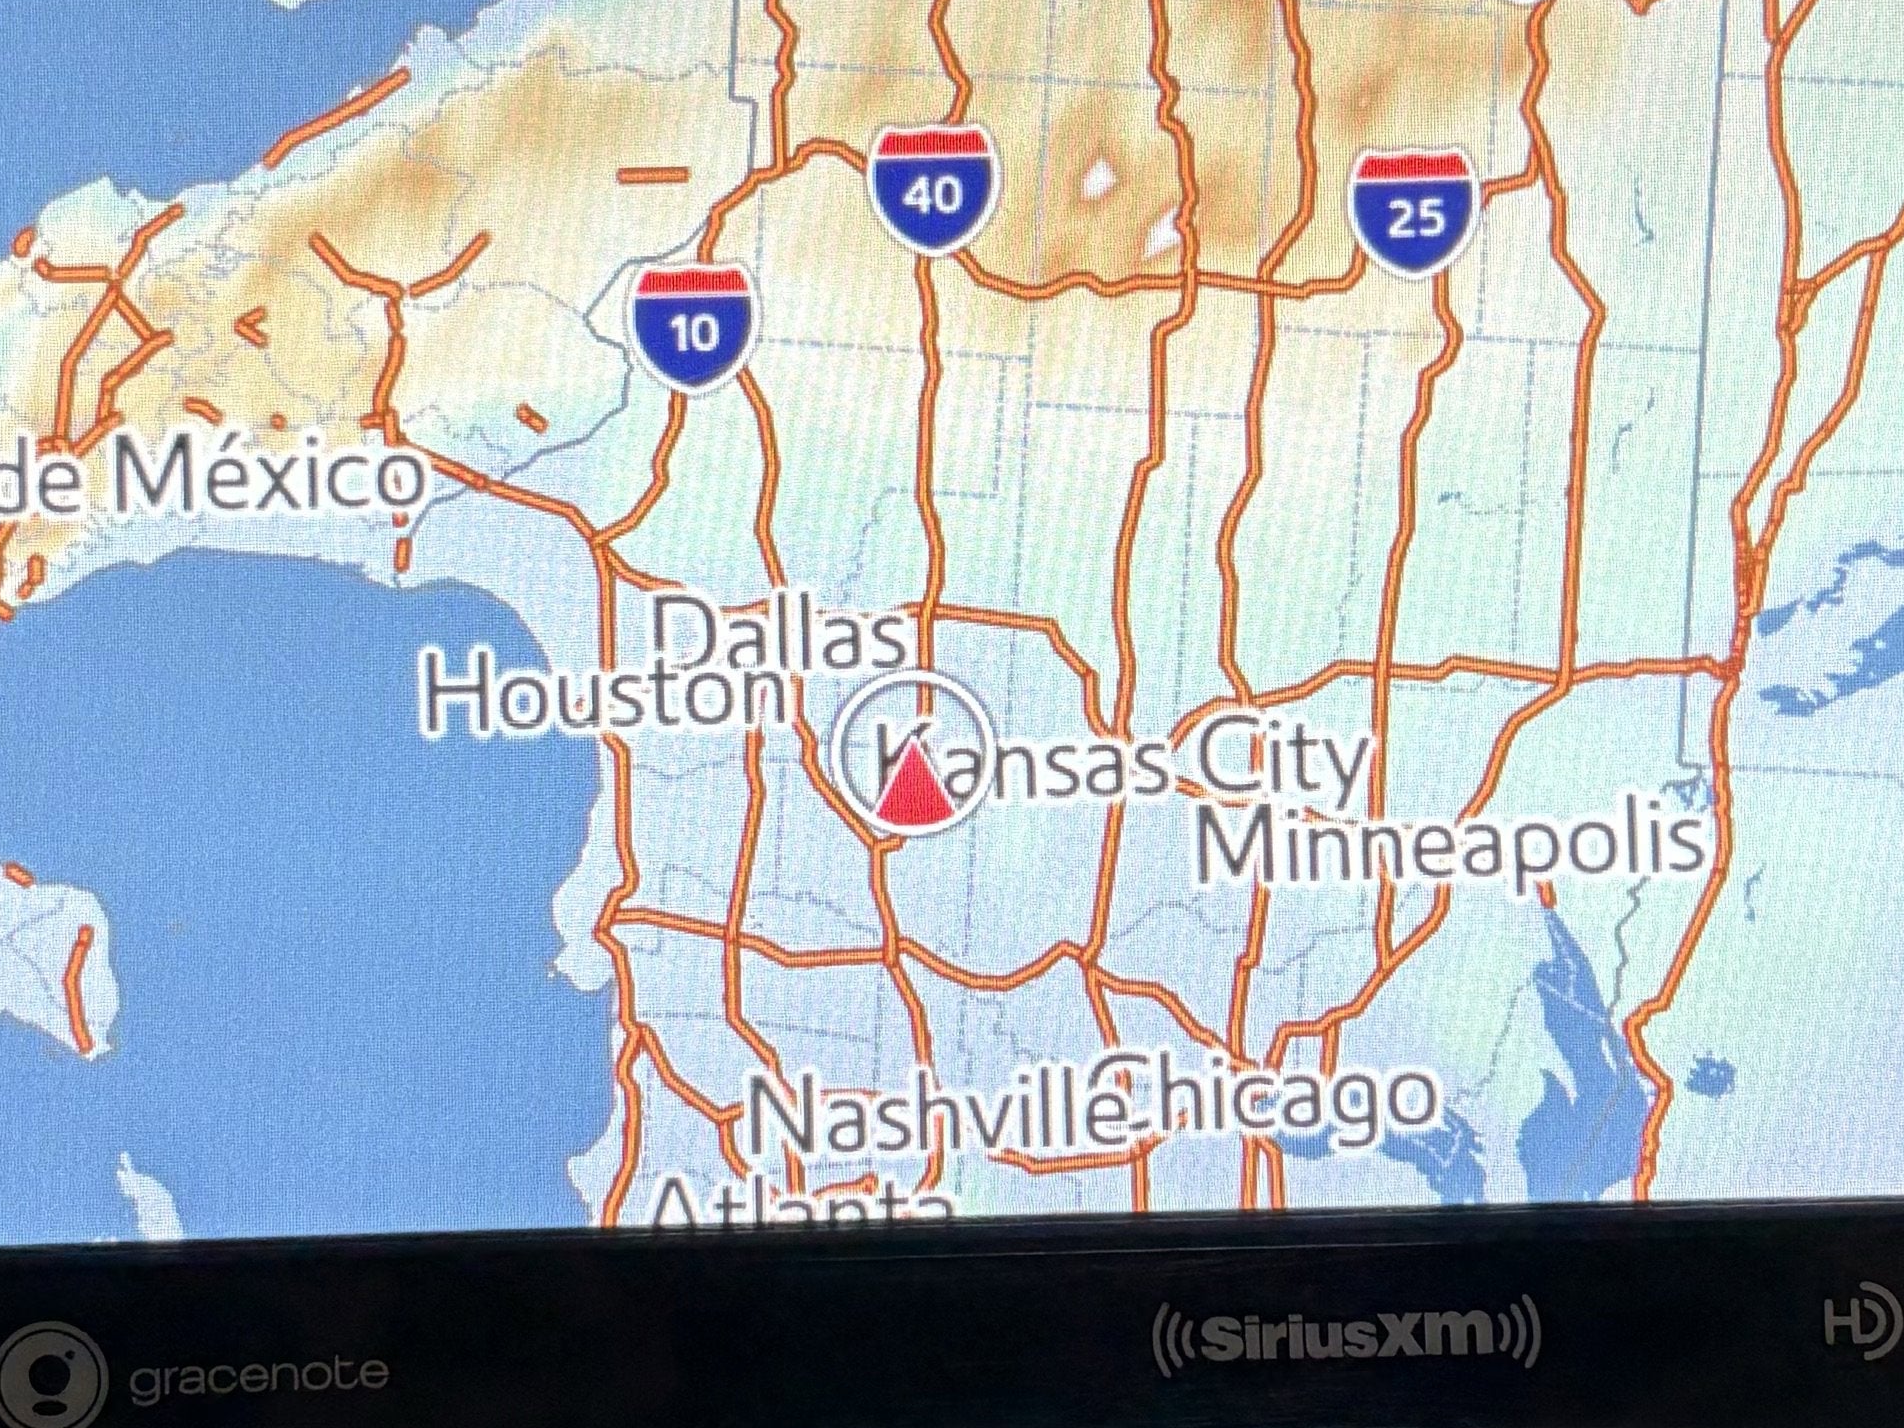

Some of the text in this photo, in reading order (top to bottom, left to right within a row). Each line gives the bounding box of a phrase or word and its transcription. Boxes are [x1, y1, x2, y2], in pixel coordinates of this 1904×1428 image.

[902, 172, 962, 216] 40
[1386, 196, 1445, 240] 25
[670, 312, 719, 356] 10
[114, 428, 426, 514] México
[653, 590, 908, 671] Dallas
[425, 650, 787, 731] Houston
[876, 712, 1371, 815] Kansas City
[1196, 792, 1707, 898] Minneapolis
[750, 1063, 1128, 1155] Nashville
[1087, 1049, 1439, 1150] Chicago
[129, 1354, 390, 1407] gracenote
